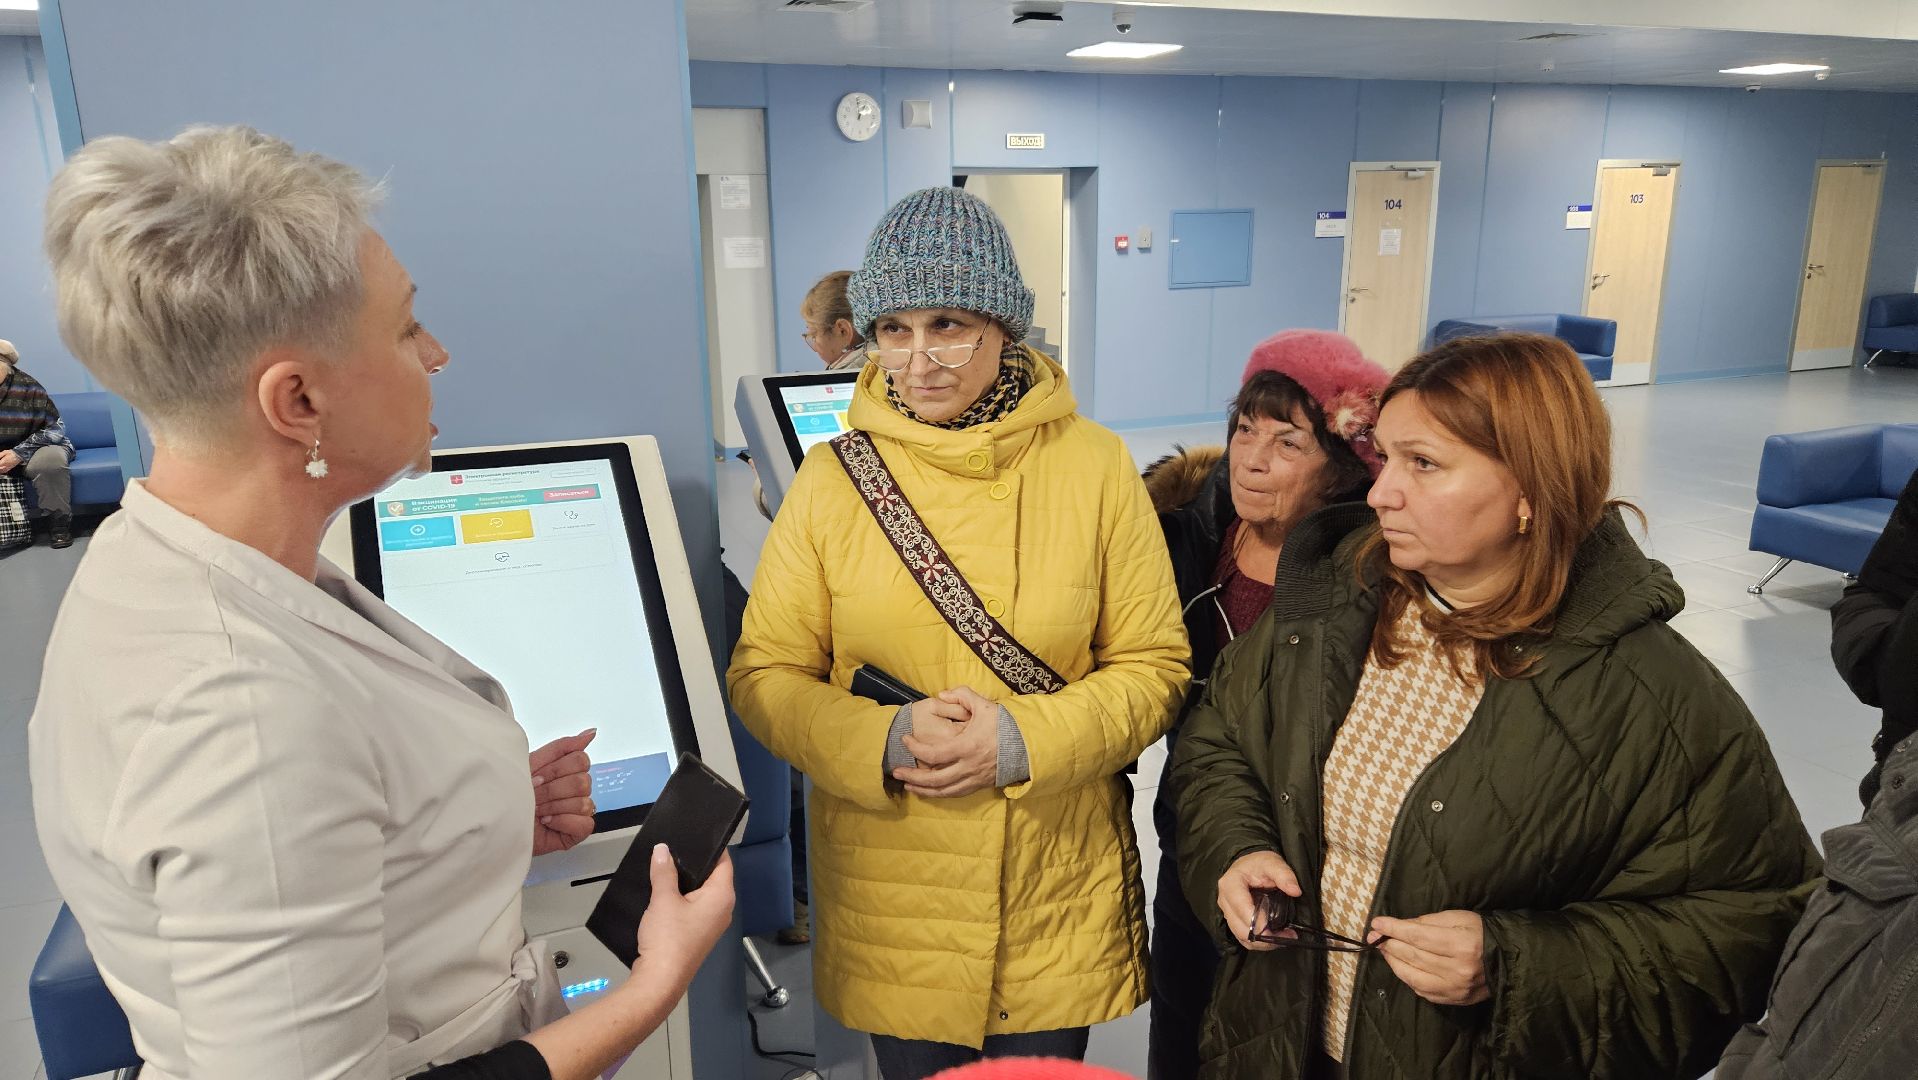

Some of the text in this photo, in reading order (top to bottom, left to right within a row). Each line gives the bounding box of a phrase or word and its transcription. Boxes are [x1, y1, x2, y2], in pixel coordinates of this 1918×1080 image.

[1010, 136, 1041, 146] ВЫХОД
[1630, 194, 1644, 204] 103
[1384, 199, 1402, 210] 104
[1319, 212, 1330, 220] 104
[422, 503, 456, 511] COVID-19
